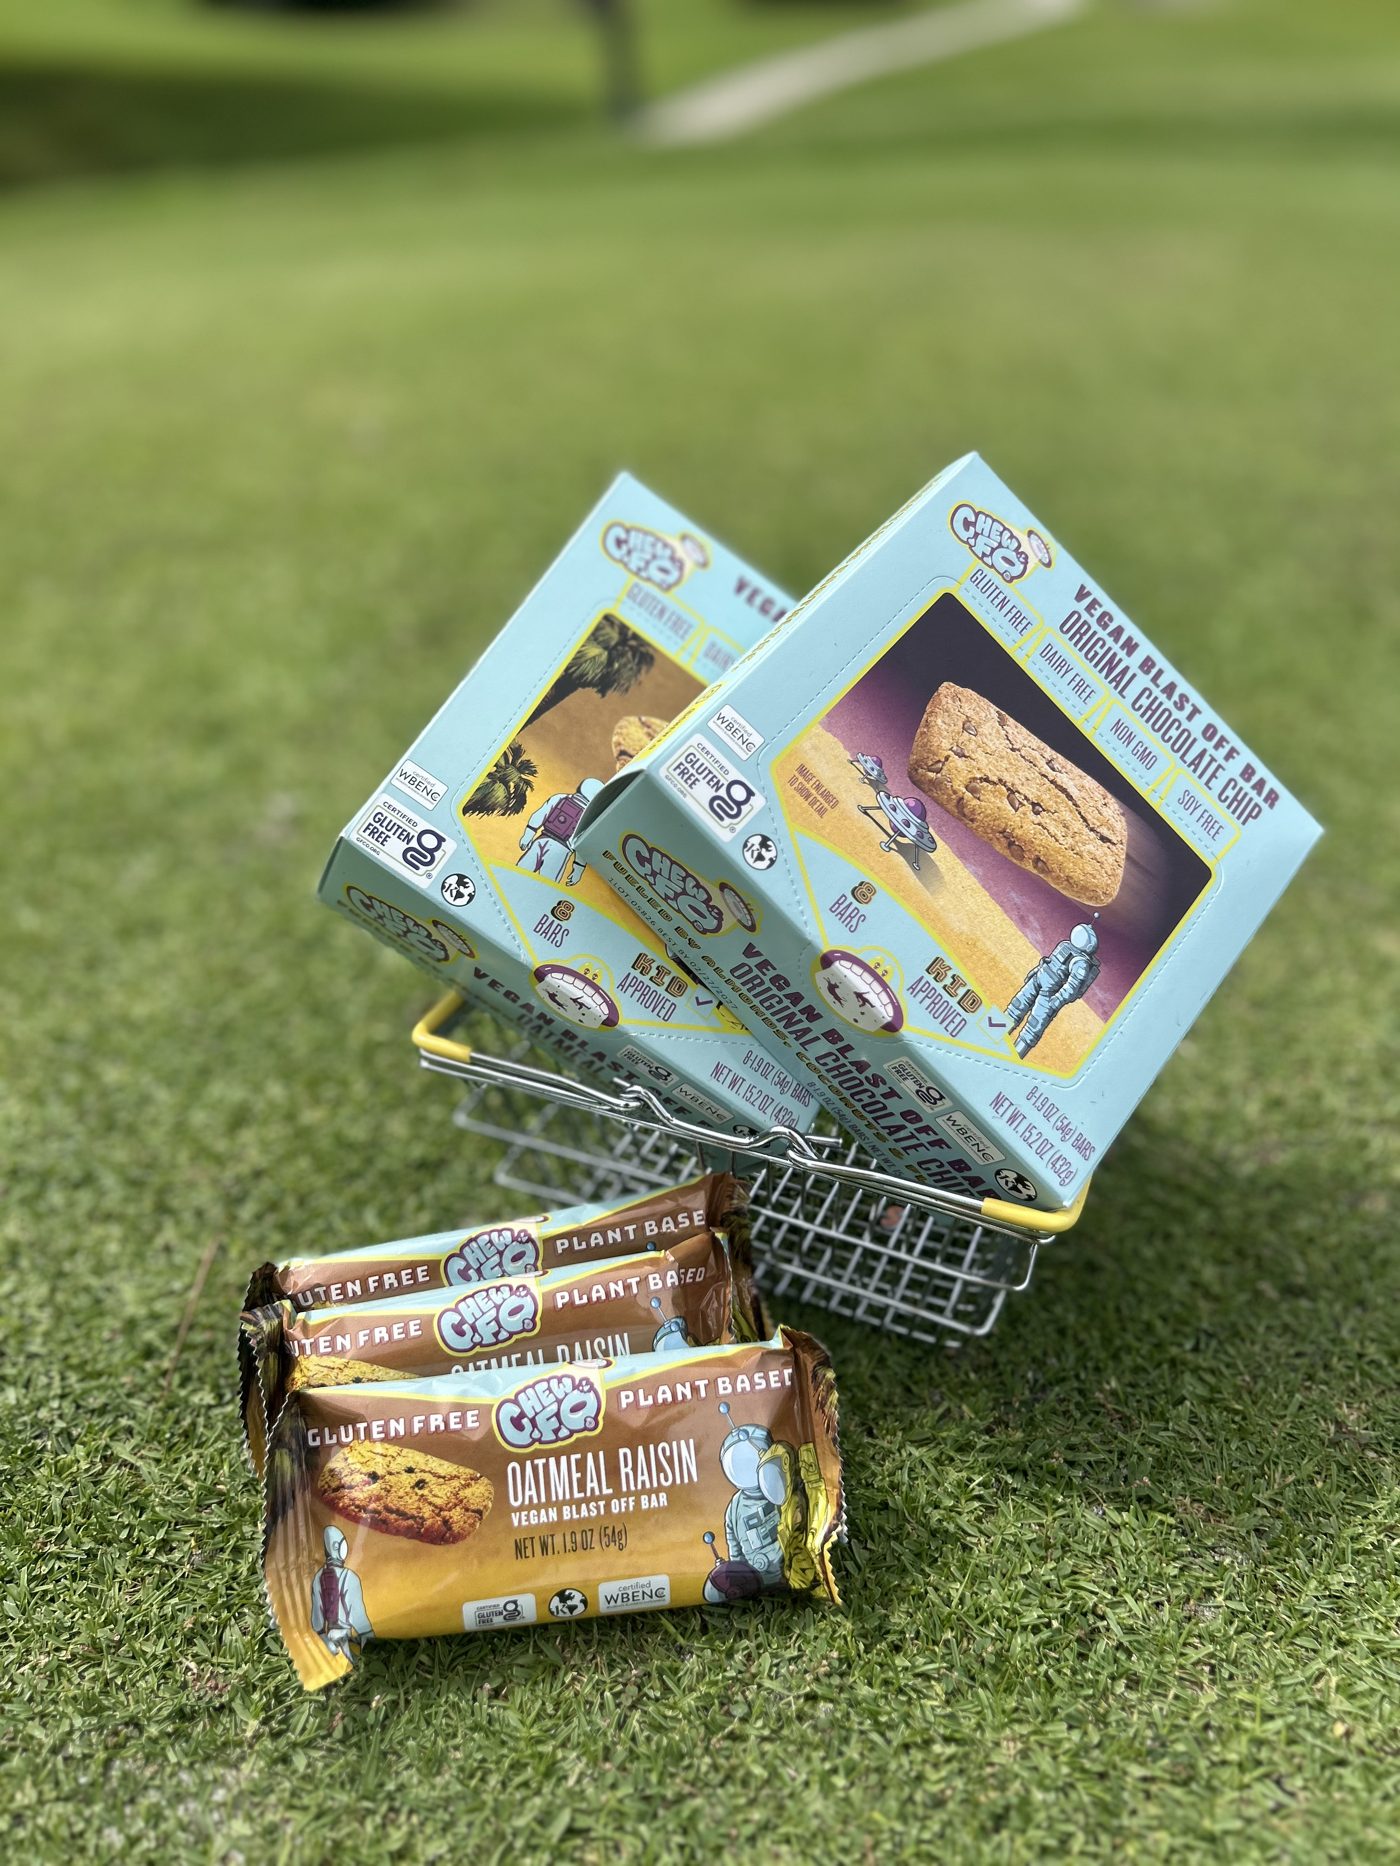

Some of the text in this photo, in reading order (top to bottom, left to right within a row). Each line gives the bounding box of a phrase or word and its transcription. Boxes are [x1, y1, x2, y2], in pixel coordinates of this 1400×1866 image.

[735, 576, 788, 622] VEG
[969, 568, 1033, 637] GLUTEN FREE
[1040, 642, 1096, 705] DAIRY FREE
[1074, 583, 1280, 810] VEGAN BLAST OFF BAR
[716, 712, 756, 753] WBENC
[730, 716, 753, 738] certified
[1059, 610, 1263, 826] ORIGINAL CHOCOLATE CHIP
[697, 742, 730, 776] CERTIFIED
[1110, 718, 1158, 771] NON GMO
[398, 768, 441, 802] WBENC
[412, 770, 436, 787] certified
[673, 762, 701, 791] FREE
[684, 752, 725, 793] GLUTEN
[795, 763, 839, 809] IMAGE ENLARGED
[382, 801, 418, 828] CERTIFIED
[788, 775, 828, 819] TO SHOW DETAIL
[1177, 789, 1225, 841] SOY FREE
[362, 823, 391, 847] FREE
[372, 811, 415, 845] GLUTEN
[550, 900, 575, 921] 8
[602, 850, 673, 922] FUELED
[674, 926, 702, 949] BY
[829, 893, 867, 933] BARS
[851, 881, 877, 905] 8
[533, 914, 570, 948] BARS
[657, 927, 677, 947] BEST
[632, 952, 689, 998] KID
[925, 956, 983, 1014] KID
[616, 972, 677, 1022] APPROVED
[907, 975, 967, 1038] APPROVED
[473, 967, 555, 1026] VEGAN
[561, 1028, 641, 1082] BLAST
[729, 962, 821, 1052] ORIGINAL
[815, 1051, 930, 1156] CHOCOLATE
[742, 942, 823, 1023] VEGAN
[821, 1027, 902, 1101] BLAST
[900, 1109, 953, 1150] OFF
[710, 1061, 733, 1085] NET
[728, 1072, 746, 1096] WT.
[742, 1083, 763, 1107] 15.2
[758, 1094, 775, 1115] OZ
[742, 1050, 814, 1108] 8-1.9 OZ (54g) BARS
[891, 1065, 909, 1082] FREE
[898, 1063, 925, 1089] GLUTEN
[946, 1115, 995, 1162] WBENC
[989, 1091, 1079, 1187] NET WT. 15.2 OZ (432g)
[1026, 1086, 1096, 1161] 8-1.9 OZ (54g) BARS
[556, 1210, 705, 1254] PLANT BASE
[298, 1265, 430, 1306] UTEN FREE
[555, 1267, 705, 1309] PLANT BASED
[287, 1319, 422, 1358] UTEN FREE
[620, 1368, 793, 1409] PLANT BASED
[307, 1409, 480, 1447] GLUTEN FREE
[507, 1438, 698, 1507] OATMEAL RAISIN
[511, 1492, 668, 1527] VEGAN BLAST OFF BAR
[514, 1523, 628, 1560] NET WT. 1.9 OZ (54g)
[604, 1587, 666, 1606] WBENC
[618, 1580, 651, 1592] certified
[477, 1610, 504, 1620] GLUTEN
[477, 1617, 494, 1625] FREE
